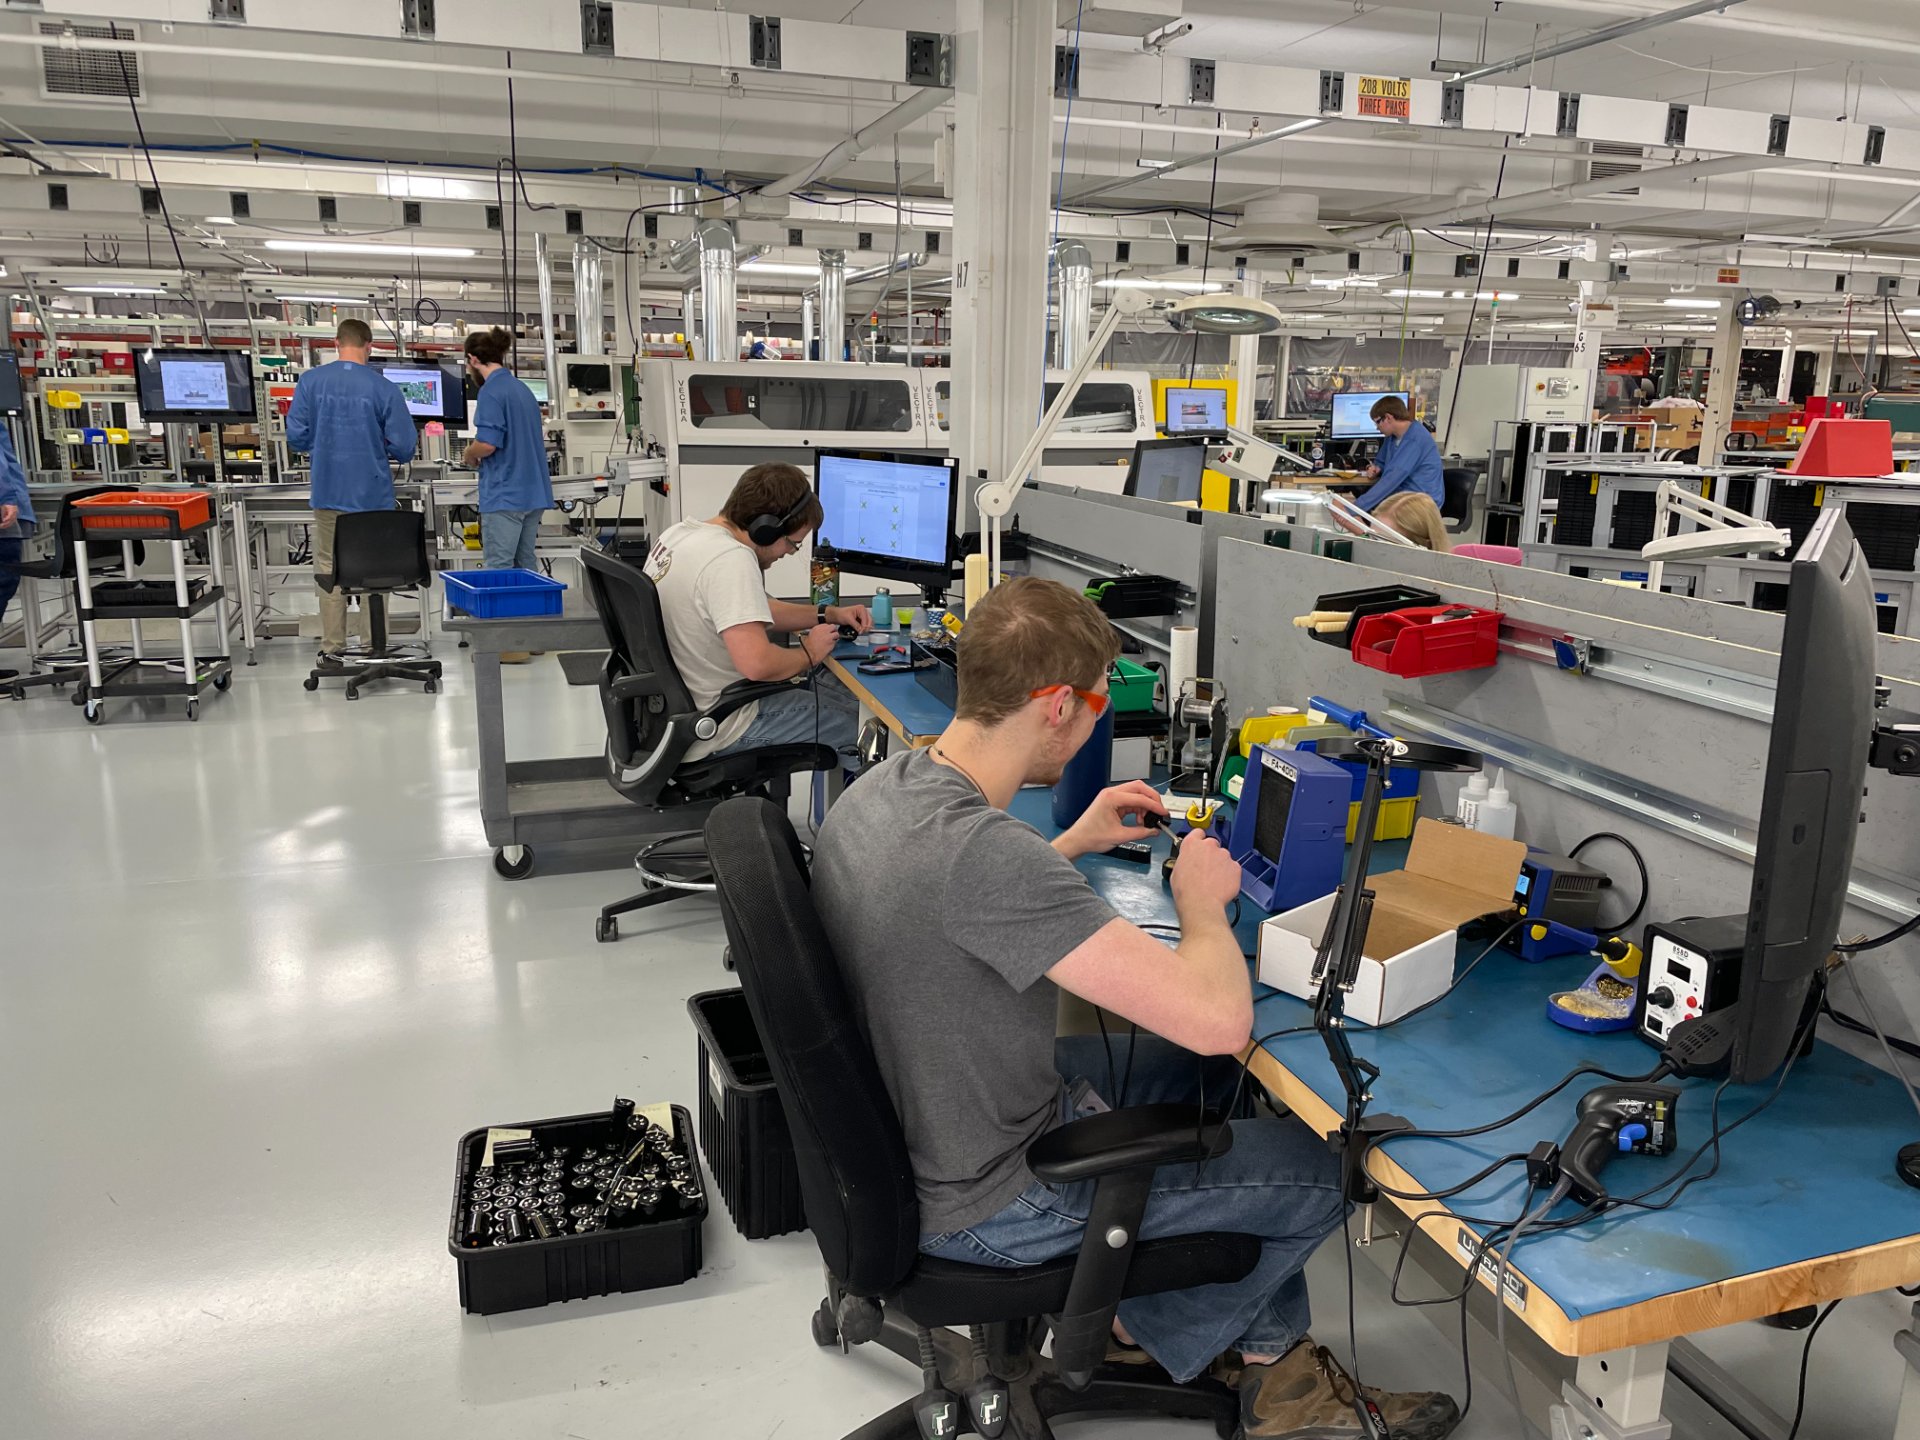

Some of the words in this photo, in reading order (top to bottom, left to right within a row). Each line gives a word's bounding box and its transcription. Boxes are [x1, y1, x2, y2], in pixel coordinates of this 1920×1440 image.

[1361, 79, 1377, 94] 208
[1382, 80, 1407, 97] VOLTS
[1360, 98, 1381, 114] THREE
[1385, 99, 1406, 116] PHASE
[957, 261, 968, 288] H7
[1578, 332, 1584, 341] G
[678, 380, 687, 422] VECTRA
[912, 386, 921, 427] VECTRA
[926, 386, 935, 427] VECTRA
[1137, 389, 1146, 428] VECTRA
